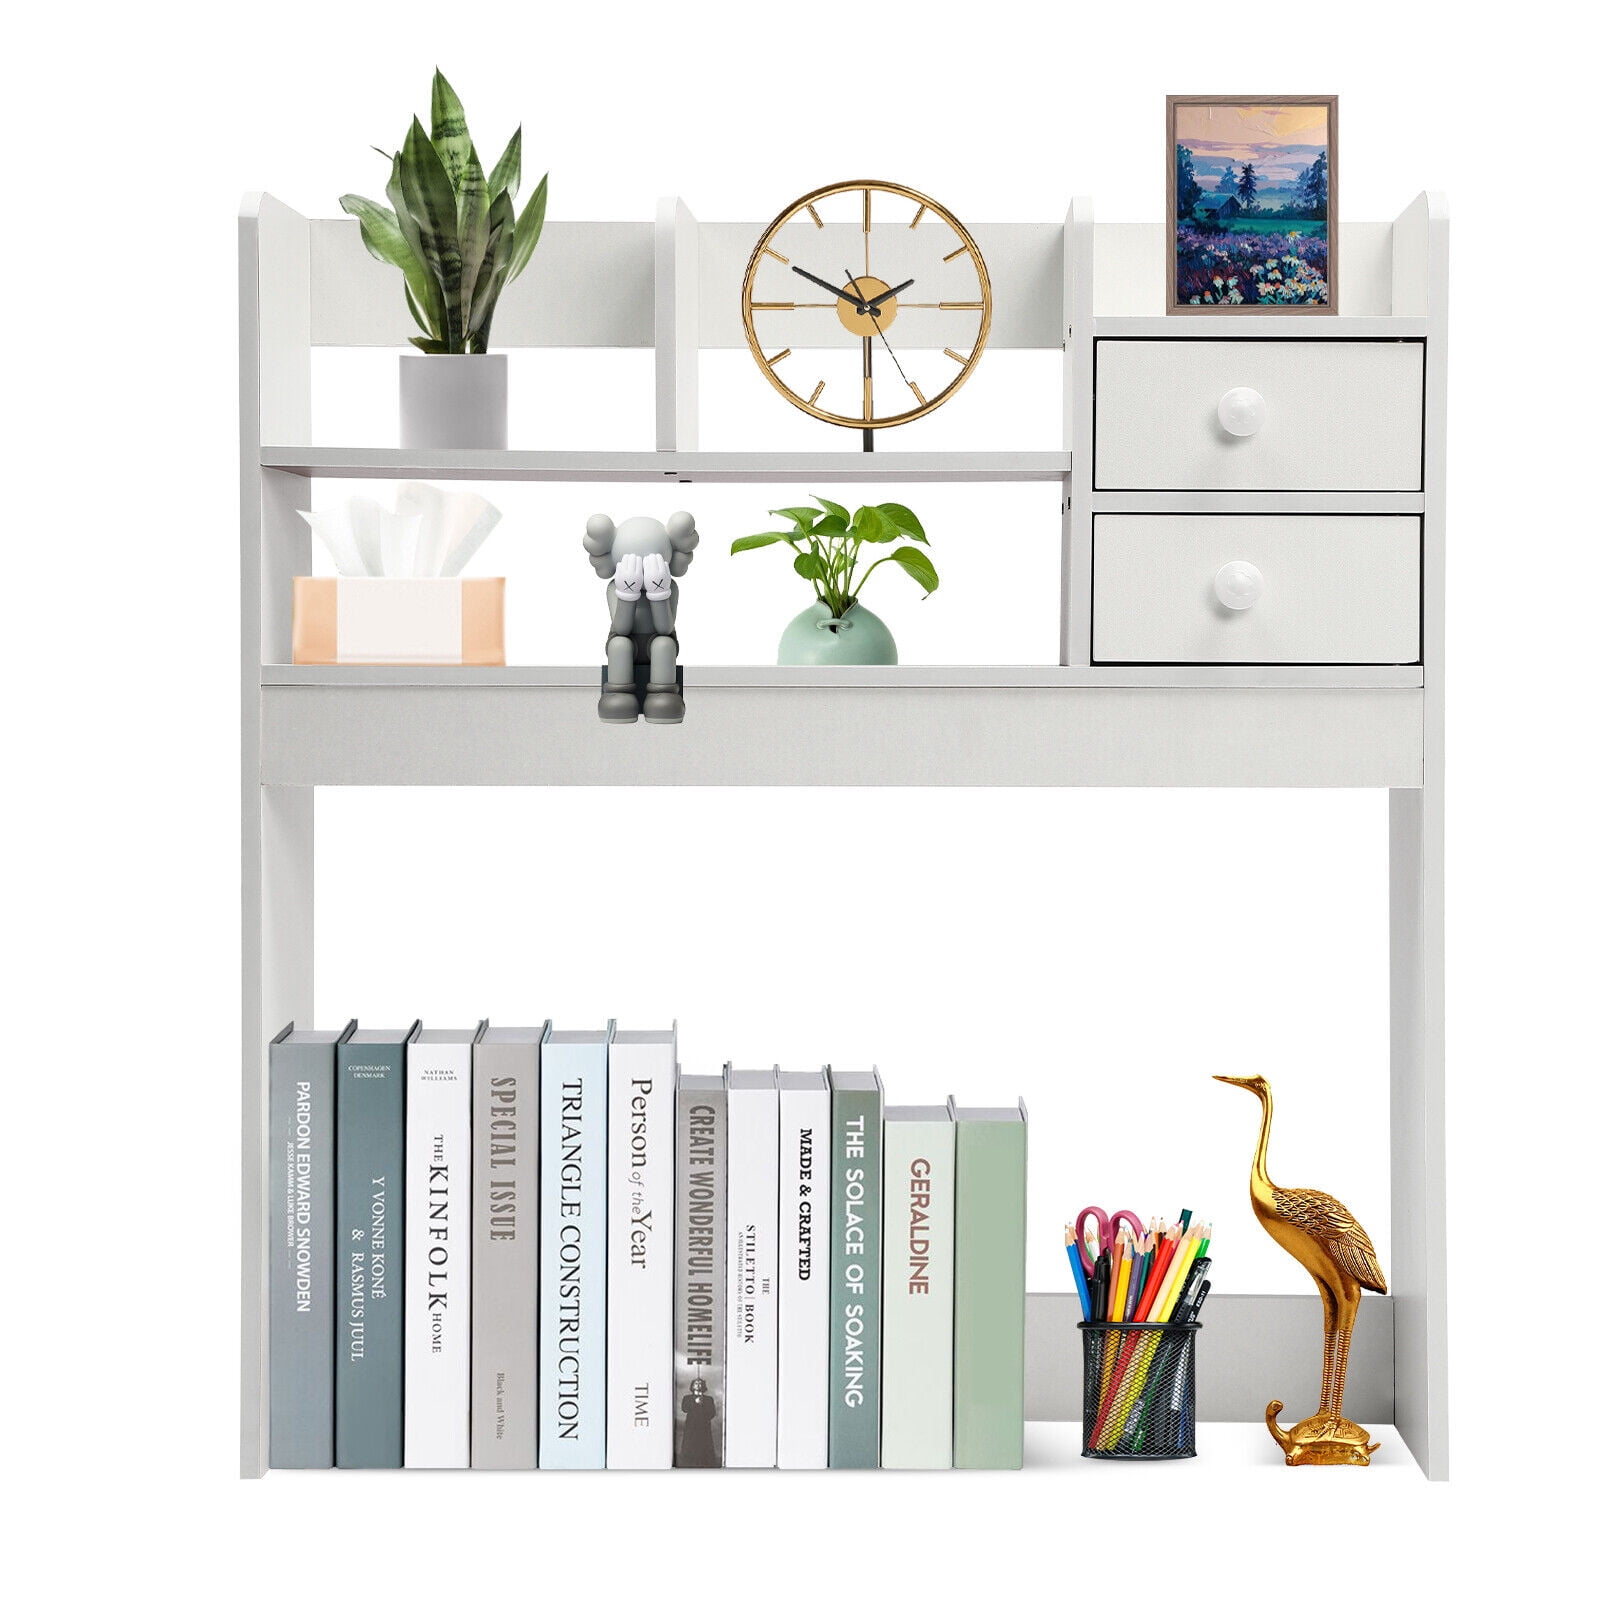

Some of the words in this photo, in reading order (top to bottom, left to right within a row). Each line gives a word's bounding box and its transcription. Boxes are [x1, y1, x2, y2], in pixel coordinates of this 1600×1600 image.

[296, 1081, 312, 1149] PARDON
[491, 1078, 516, 1168] SPECIAL
[631, 1078, 653, 1168] Person
[689, 1104, 715, 1166] CREATE
[846, 1116, 864, 1158] THE
[287, 1141, 295, 1162] JESSE
[434, 1135, 443, 1161] THE
[561, 1078, 582, 1217] TRIANGLE
[800, 1129, 812, 1179] MADE
[287, 1163, 295, 1188] KAMM
[296, 1153, 312, 1224] EDWARD
[627, 1171, 644, 1187] of
[800, 1184, 811, 1196] &
[287, 1195, 295, 1214] LUKE
[287, 1215, 295, 1247] BROWER
[490, 1181, 516, 1240] ISSUE
[632, 1192, 646, 1216] the
[688, 1170, 715, 1276] WONDERFUL
[846, 1168, 864, 1255] SOLACE
[909, 1159, 930, 1294] GERALDINE
[352, 1229, 364, 1240] &
[429, 1165, 448, 1310] KINFOLK
[631, 1210, 653, 1270] Year
[746, 1225, 755, 1294] STILETTO
[799, 1202, 811, 1280] CRAFTED
[296, 1228, 312, 1312] SNOWDEN
[352, 1253, 364, 1317] RASMUS
[372, 1254, 386, 1298] KONÉ
[846, 1264, 864, 1294] OF
[349, 1322, 363, 1361] JUUL
[432, 1313, 441, 1352] HOME
[559, 1225, 580, 1439] CONSTRUCTION
[686, 1282, 714, 1366] HOMELIFE
[745, 1305, 754, 1342] BOOK
[845, 1304, 863, 1407] SOAKING
[496, 1397, 505, 1412] and
[496, 1415, 505, 1440] White
[635, 1383, 648, 1426] TIME
